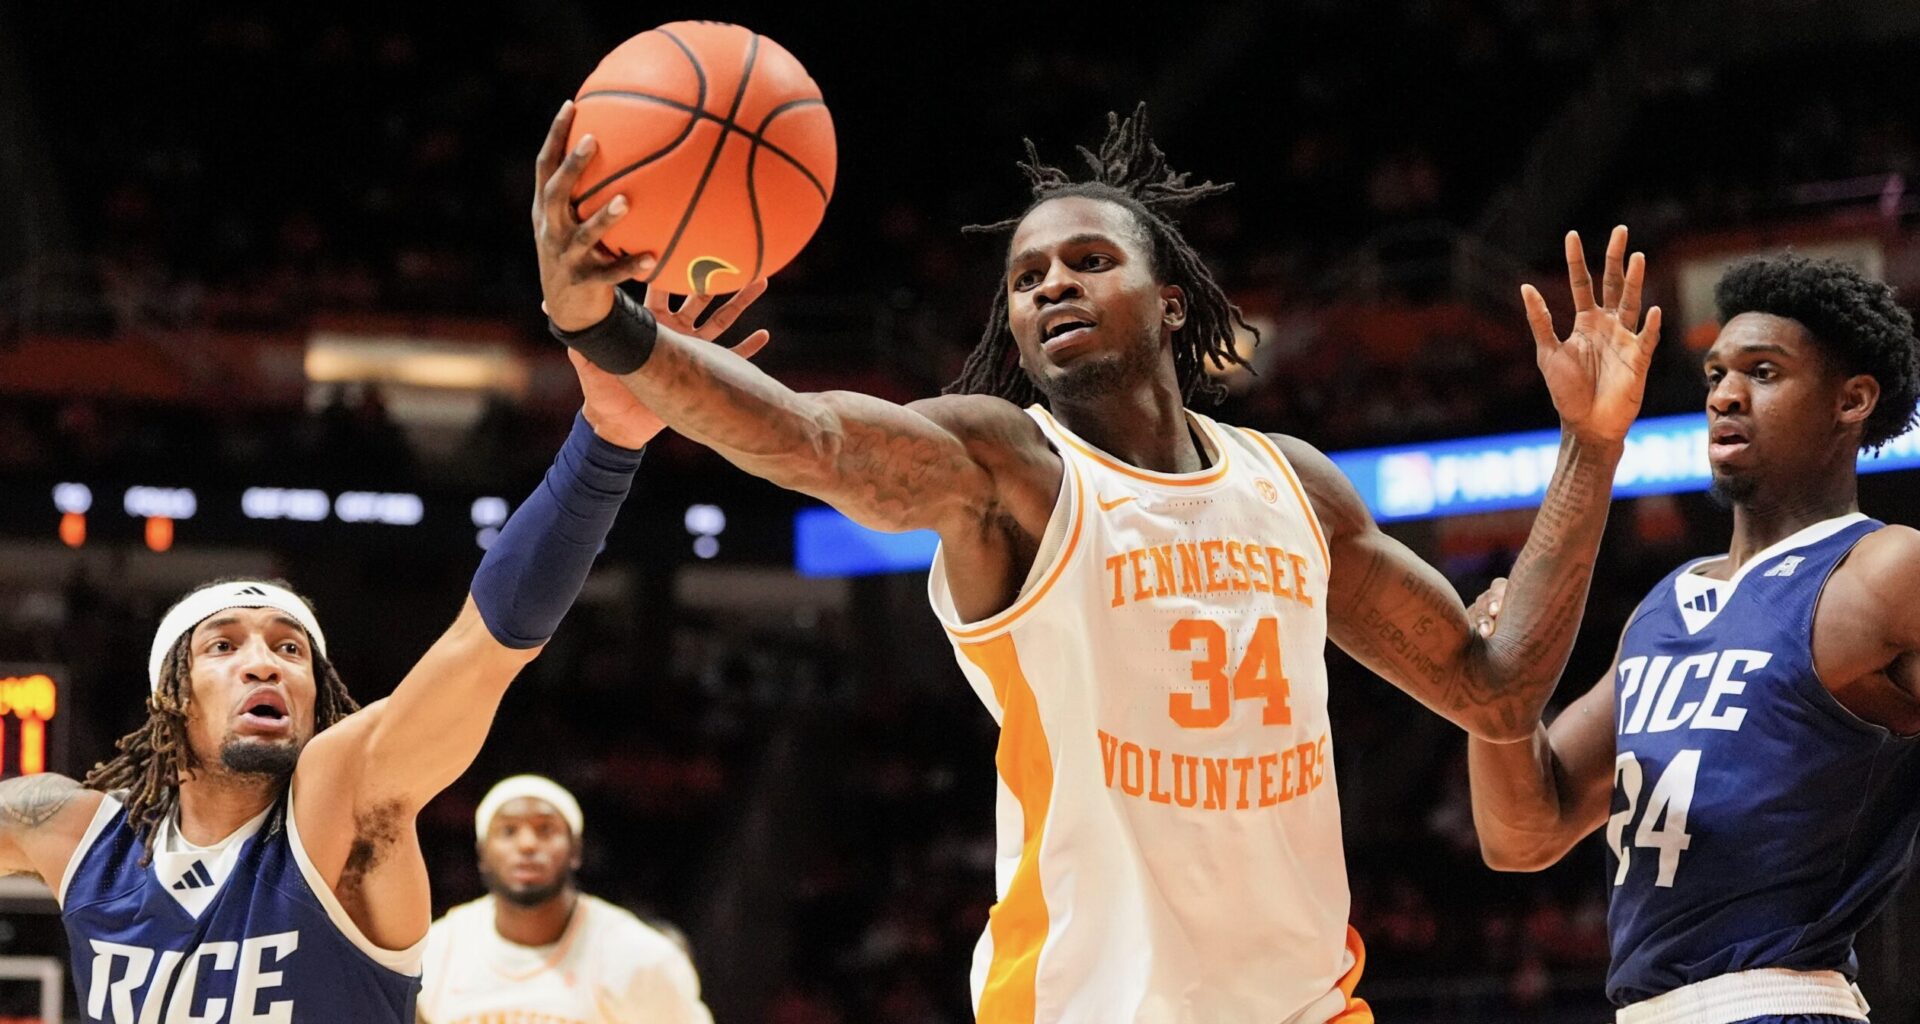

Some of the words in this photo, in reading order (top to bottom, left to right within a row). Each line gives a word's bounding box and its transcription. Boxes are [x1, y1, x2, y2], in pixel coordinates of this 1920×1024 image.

[1106, 539, 1313, 609] TENNESSEE
[1169, 617, 1292, 729] 34
[1097, 728, 1327, 811] VOLUNTEERS
[1606, 749, 1702, 888] 24
[88, 930, 299, 1024] RICE
